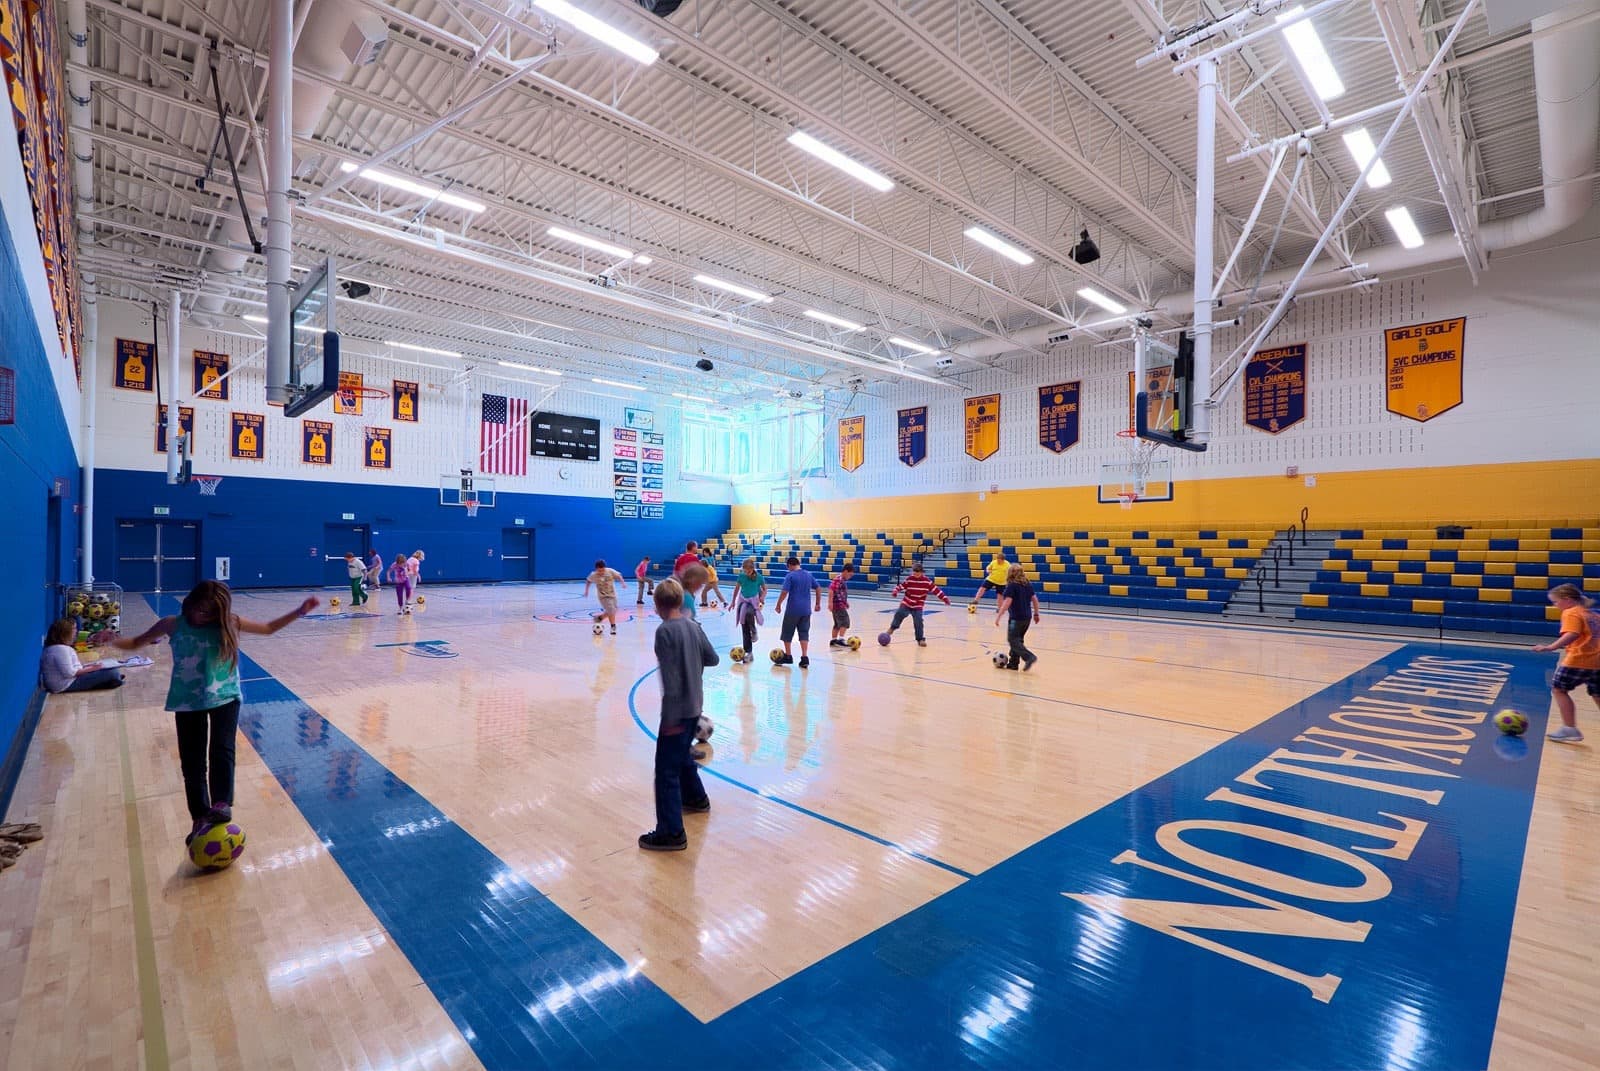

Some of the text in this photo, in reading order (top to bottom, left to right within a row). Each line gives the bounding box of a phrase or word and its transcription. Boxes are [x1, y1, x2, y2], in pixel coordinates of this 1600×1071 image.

[1392, 322, 1458, 340] GIRLS GOLF
[1394, 350, 1456, 367] SVC CHAMPIONS
[129, 365, 140, 373] 22
[1264, 371, 1302, 384] CHAMPIONS
[244, 436, 251, 444] 21
[1060, 696, 1489, 1004] ROYALTON
